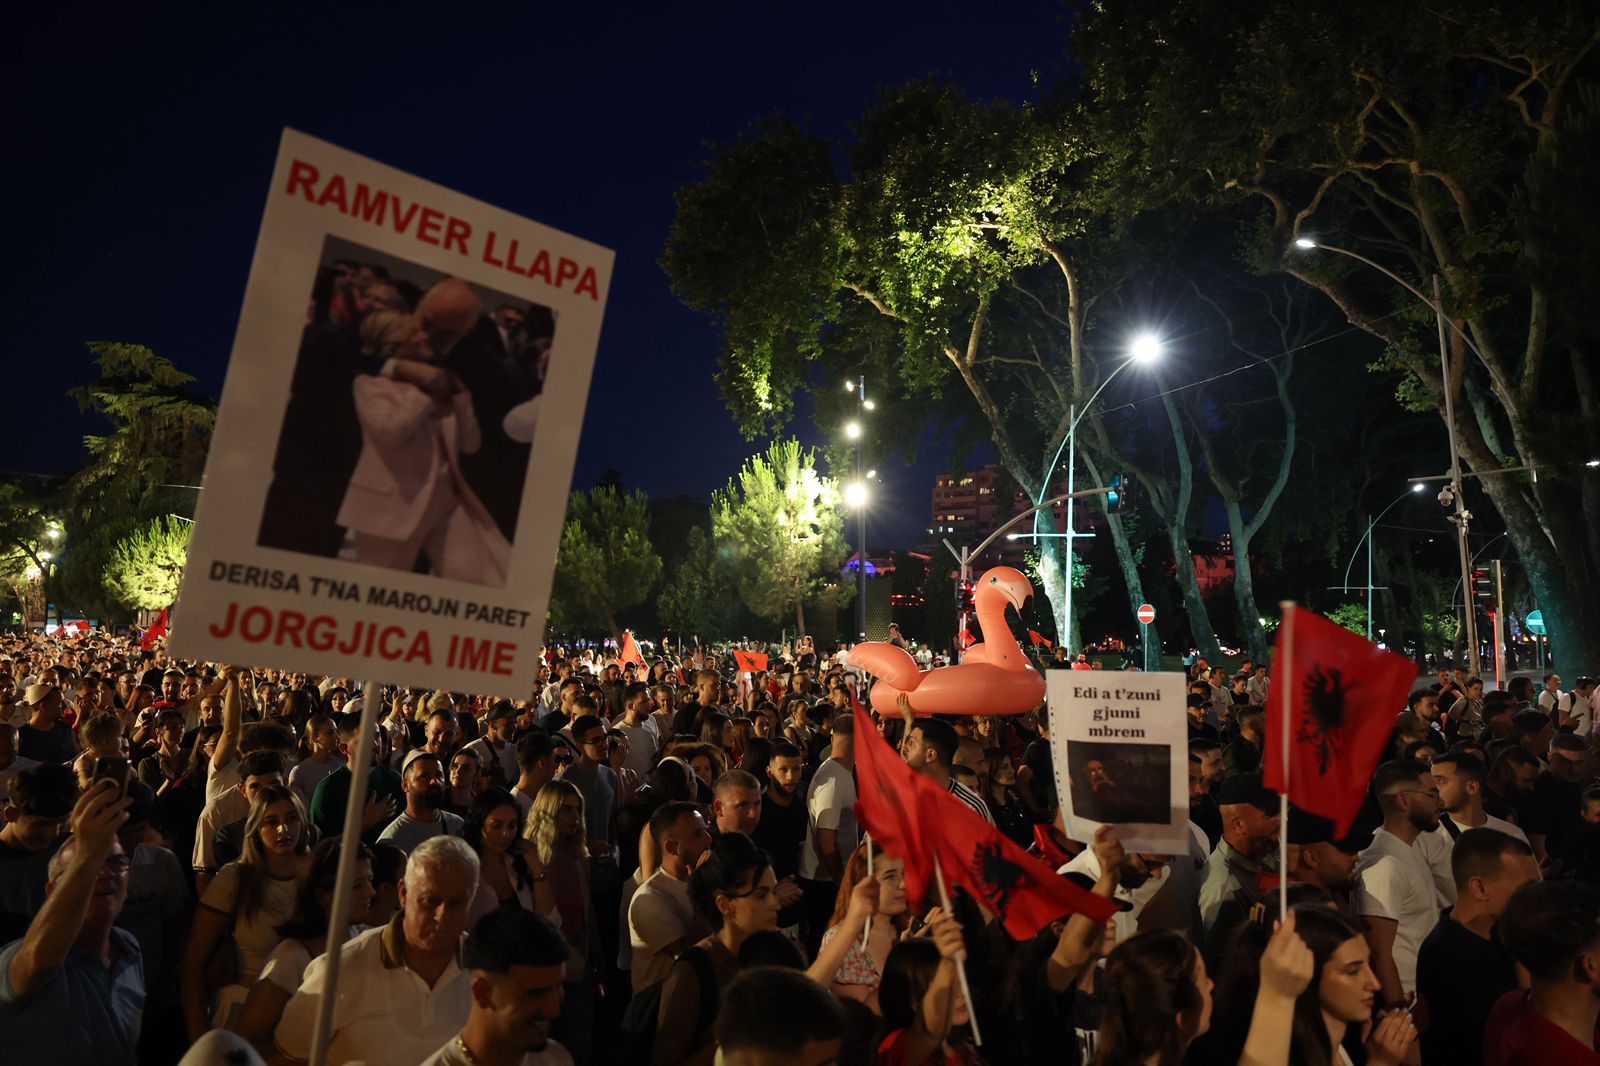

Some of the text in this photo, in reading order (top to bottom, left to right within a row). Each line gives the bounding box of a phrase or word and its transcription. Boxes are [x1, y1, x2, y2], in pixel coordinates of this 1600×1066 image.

[285, 158, 599, 301] RAMVER LLAPA
[208, 560, 530, 629] DERISA T'NA MAROJN PARET
[208, 602, 517, 676] JORGJICA IME
[1073, 687, 1098, 699] Edi
[1102, 690, 1111, 700] a
[1093, 706, 1141, 721] gjumi
[1088, 725, 1146, 738] mbrem
